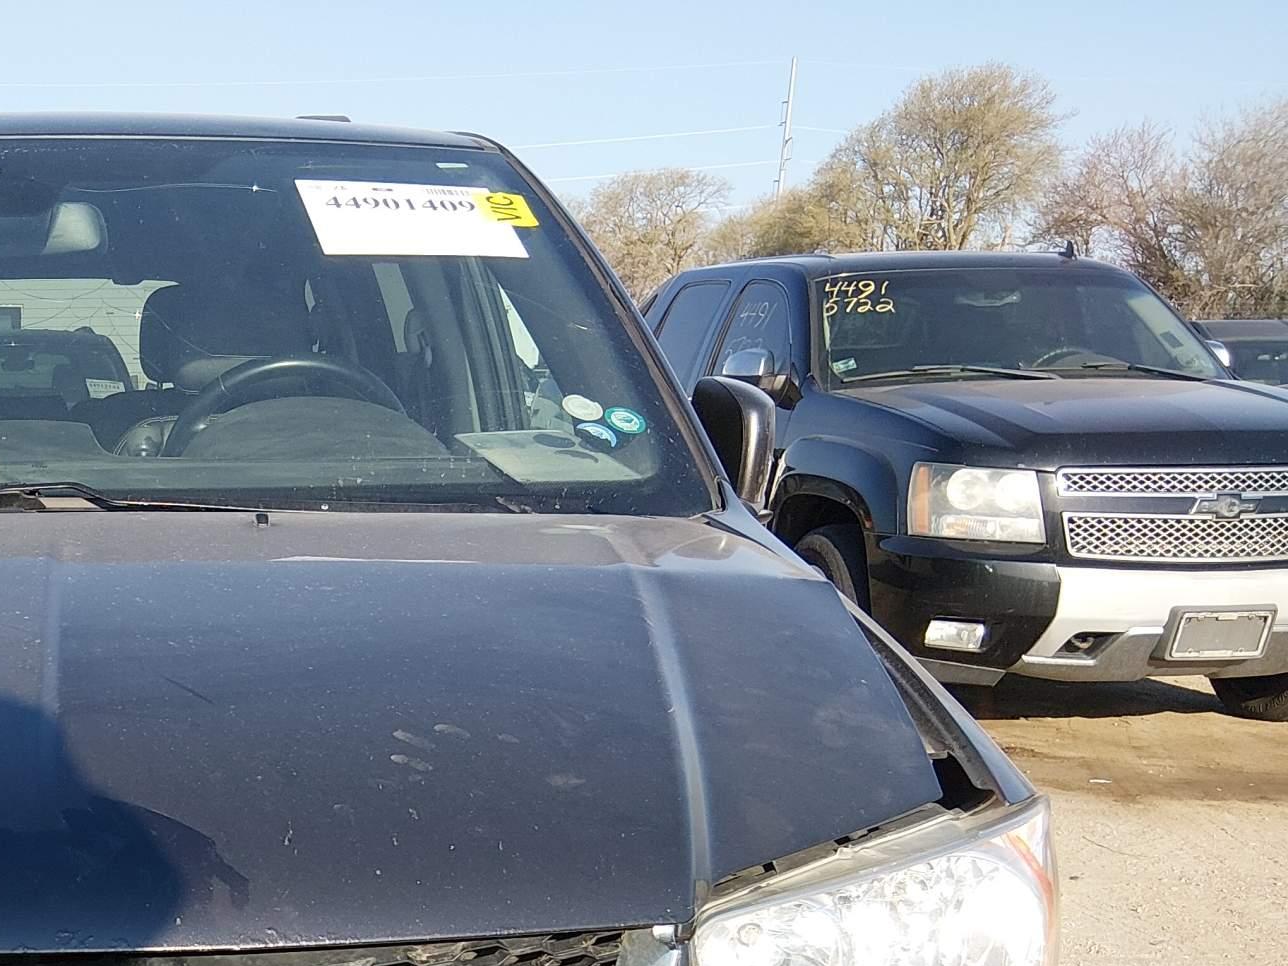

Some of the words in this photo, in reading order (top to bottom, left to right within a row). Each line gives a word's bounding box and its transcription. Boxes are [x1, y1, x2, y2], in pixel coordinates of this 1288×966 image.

[325, 195, 475, 213] 44901409
[485, 194, 523, 222] VIC
[824, 280, 889, 298] 4491
[824, 297, 896, 316] 5722
